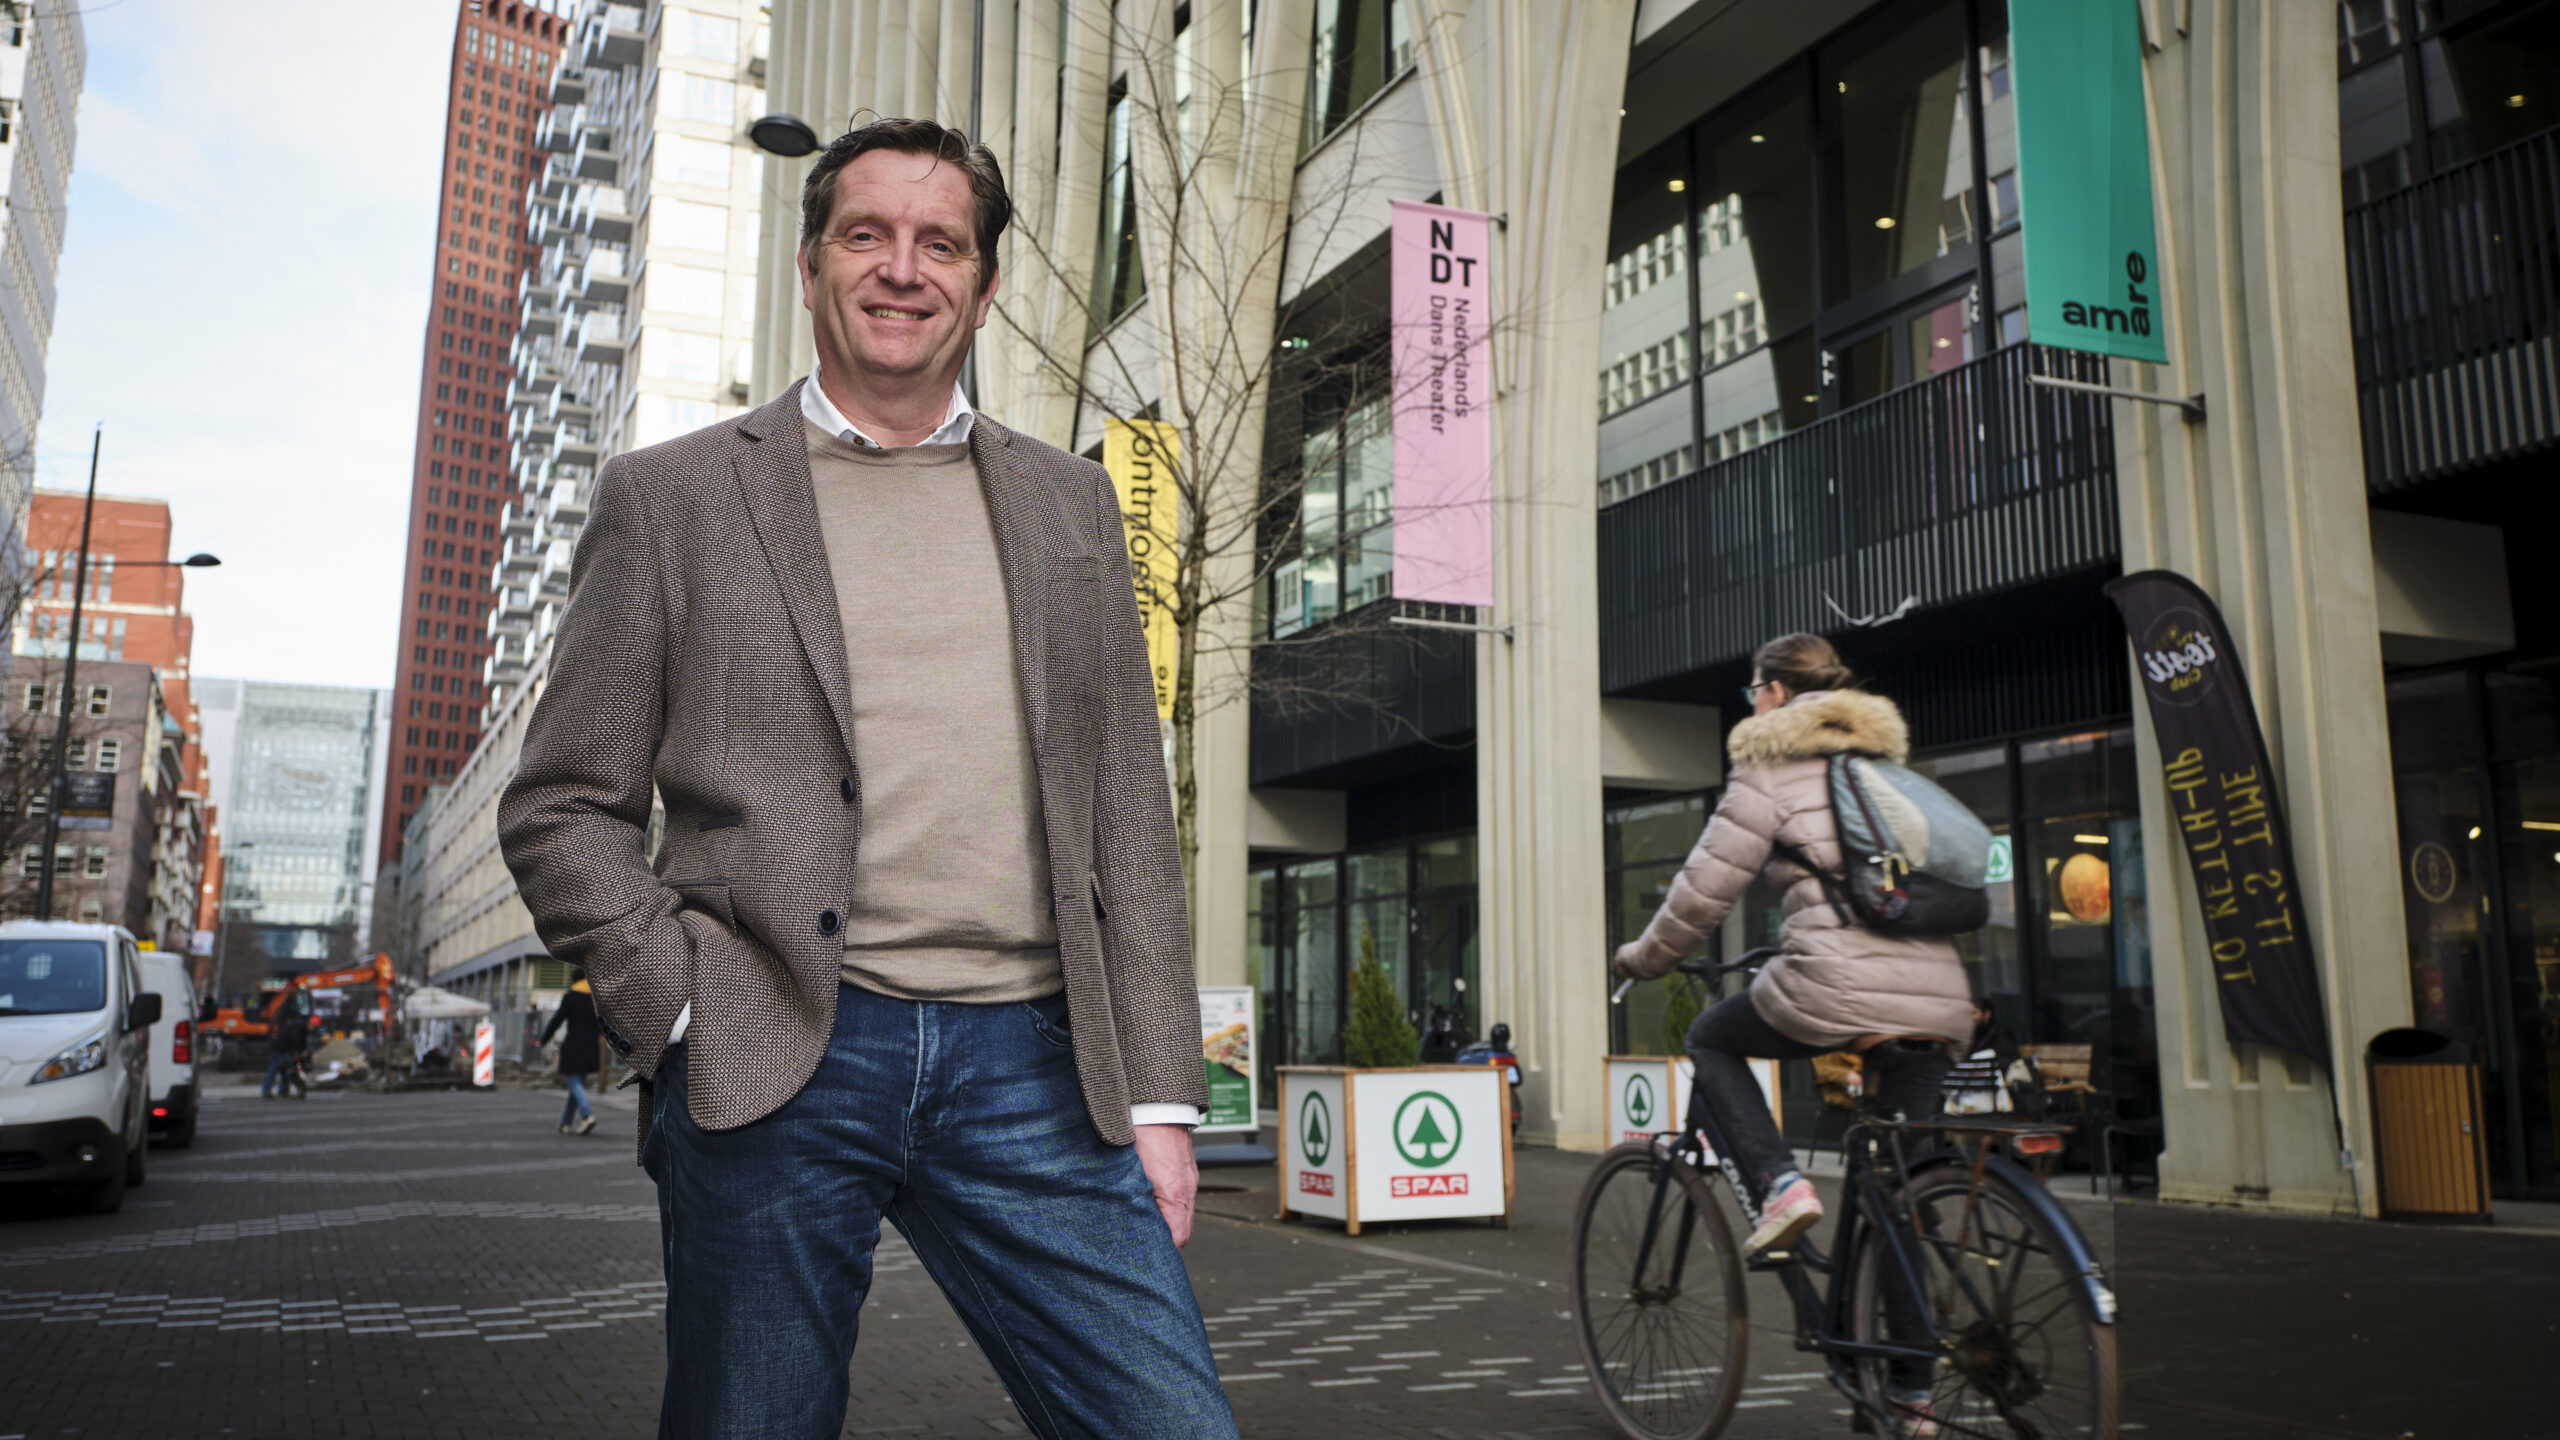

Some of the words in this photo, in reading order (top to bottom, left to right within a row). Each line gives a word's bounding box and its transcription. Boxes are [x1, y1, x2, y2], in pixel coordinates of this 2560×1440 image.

[1430, 294, 1448, 346] Dans
[2061, 250, 2151, 338] amare
[1453, 297, 1471, 419] Nederlands
[1431, 353, 1448, 436] Theater
[1300, 1172, 1333, 1194] SPAR
[1392, 1175, 1467, 1196] SPAR
